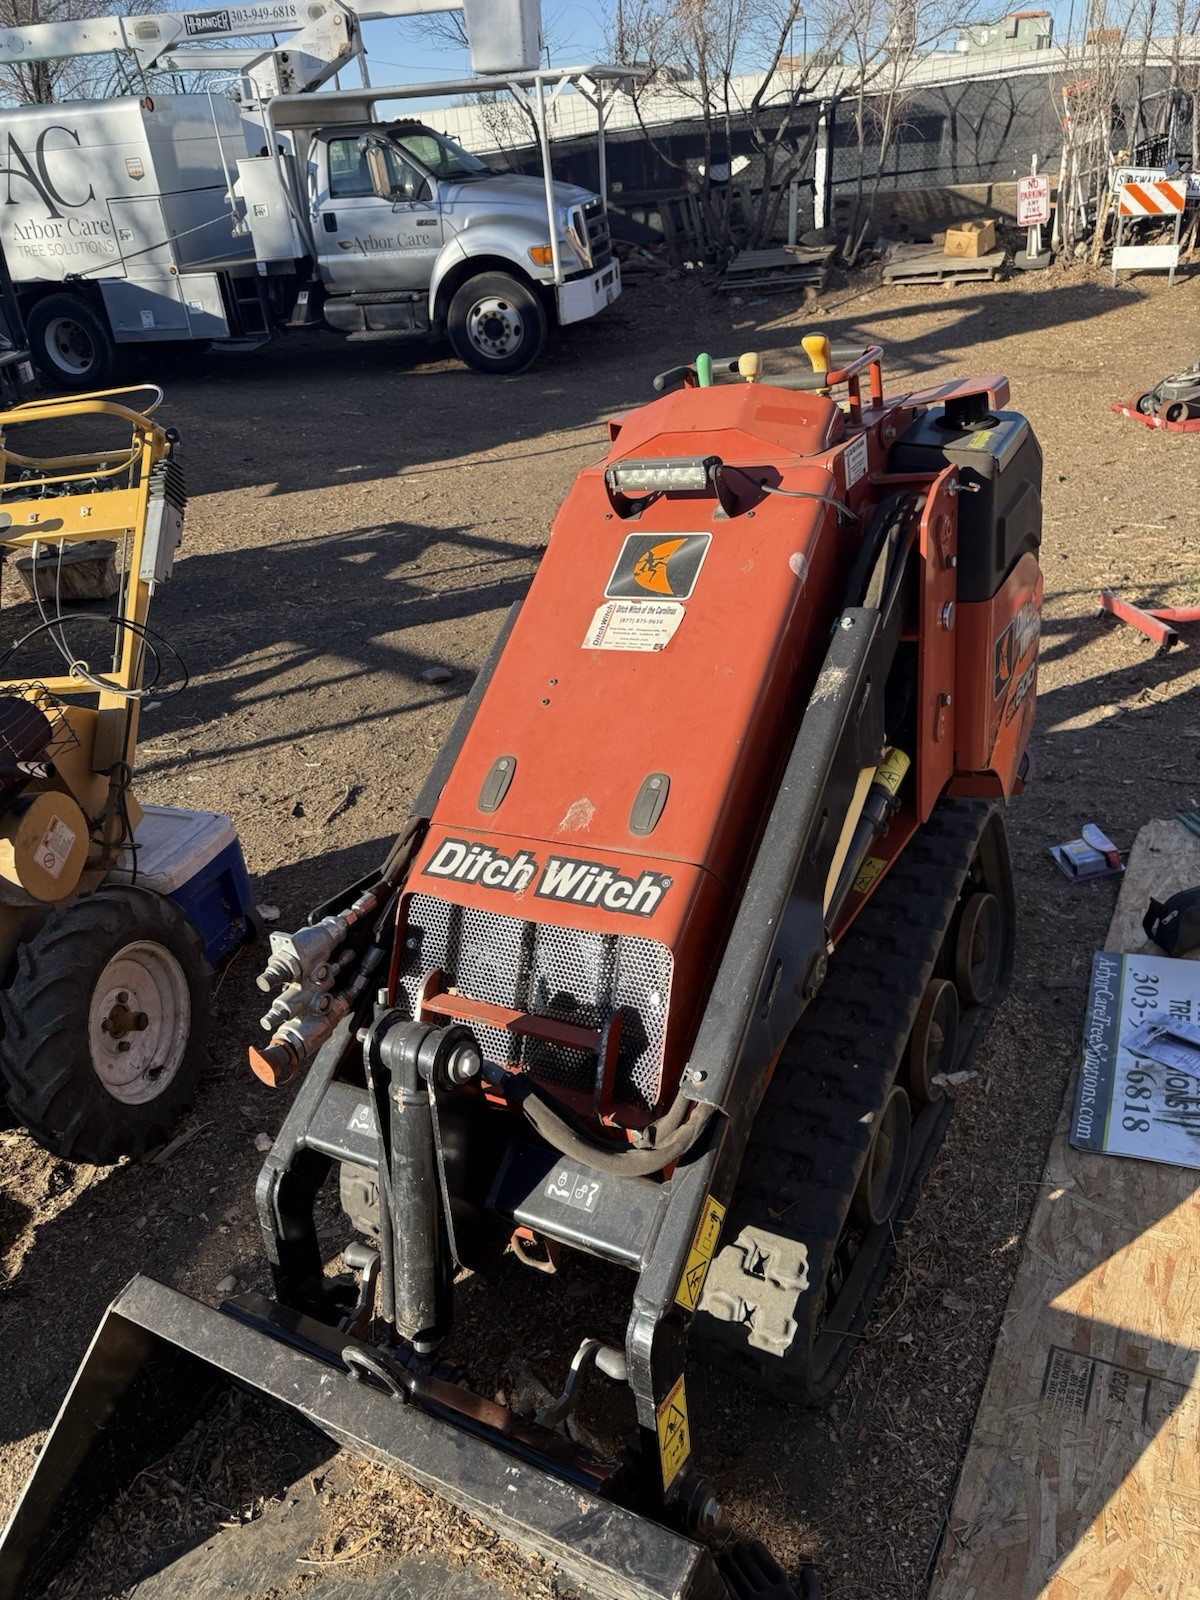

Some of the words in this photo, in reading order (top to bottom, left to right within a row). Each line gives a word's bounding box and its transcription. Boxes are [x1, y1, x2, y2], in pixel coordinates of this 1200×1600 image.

[184, 11, 231, 35] HI-RANGER
[231, 5, 297, 23] 303-949-6818
[1020, 188, 1047, 201] PARKING
[1028, 179, 1039, 190] NO
[14, 219, 63, 241] Arbor
[67, 217, 112, 237] Care
[17, 244, 46, 258] TREE
[49, 240, 115, 257] SOLUTIONS
[352, 234, 394, 257] Arbor
[396, 232, 430, 248] Care
[427, 841, 534, 889] Ditch
